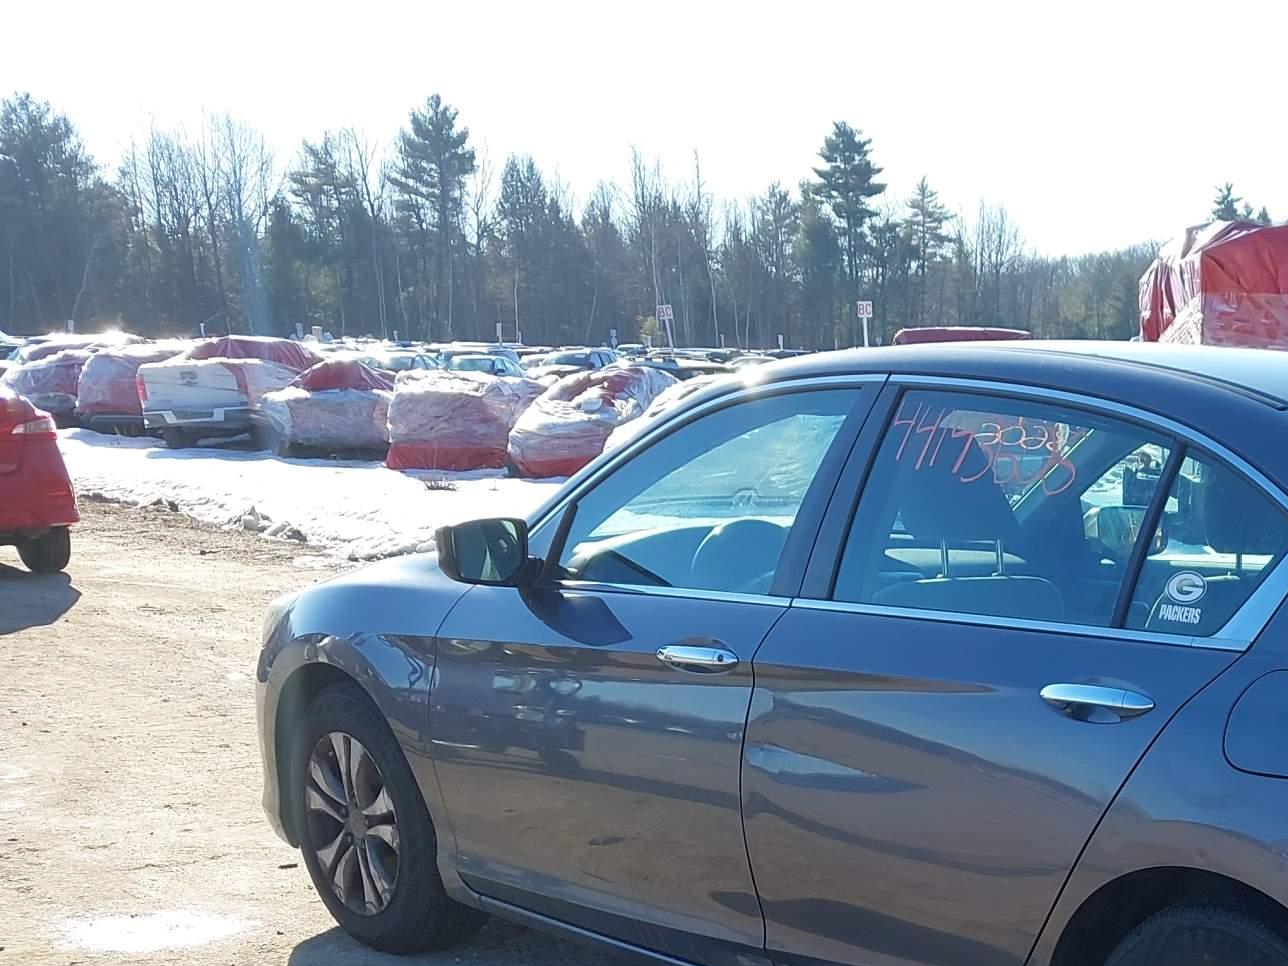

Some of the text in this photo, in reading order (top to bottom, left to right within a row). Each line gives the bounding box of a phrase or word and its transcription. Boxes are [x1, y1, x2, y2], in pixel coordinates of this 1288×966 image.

[859, 304, 871, 315] BC
[1168, 573, 1204, 602] G
[1159, 604, 1201, 624] PACKERS
